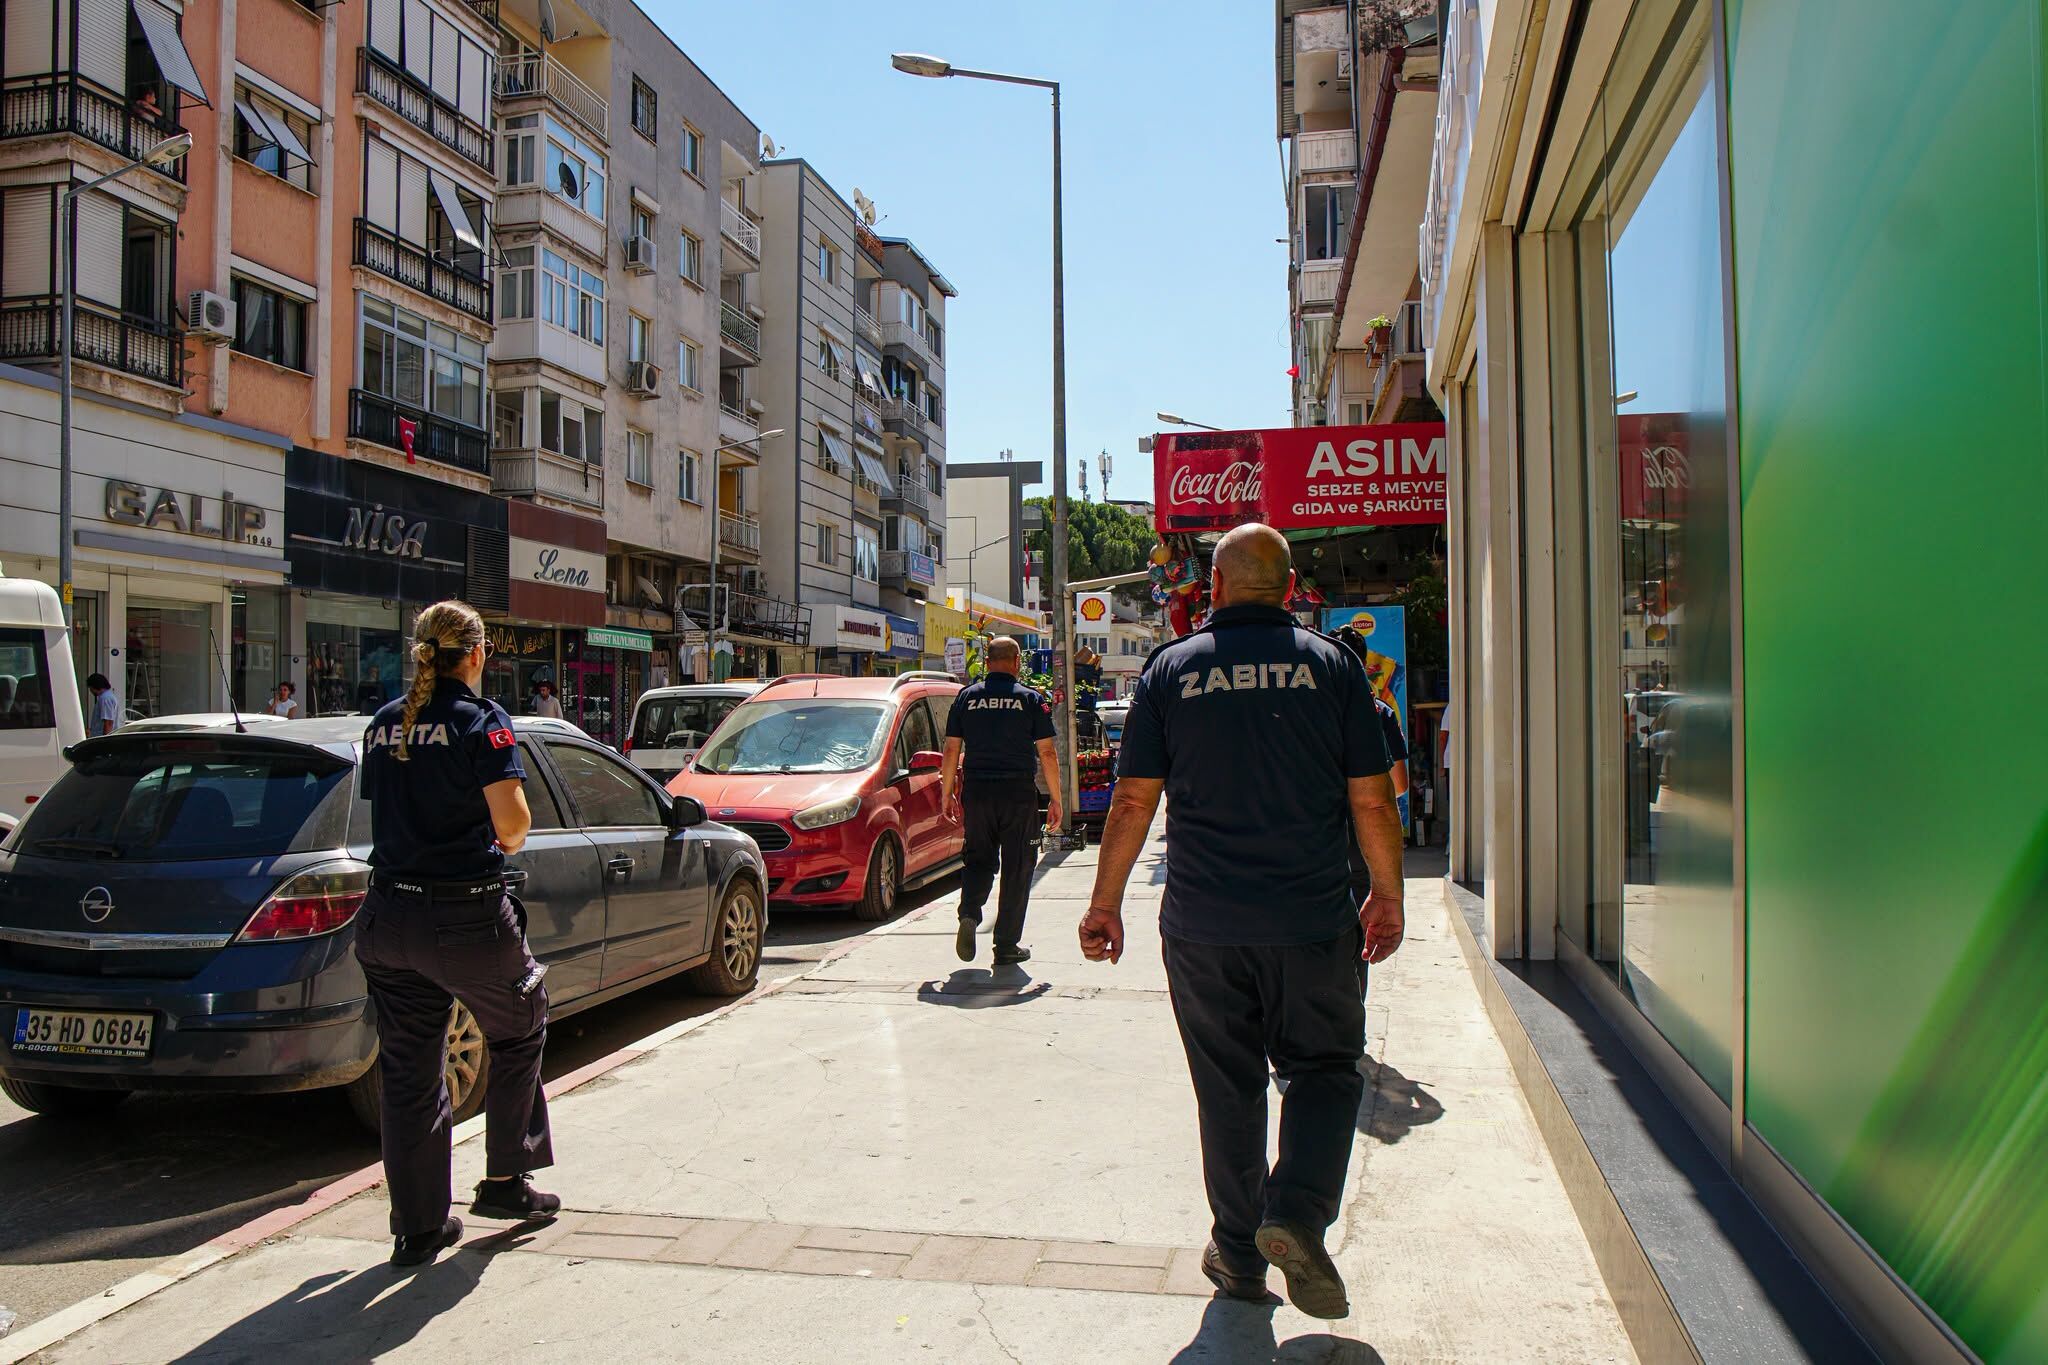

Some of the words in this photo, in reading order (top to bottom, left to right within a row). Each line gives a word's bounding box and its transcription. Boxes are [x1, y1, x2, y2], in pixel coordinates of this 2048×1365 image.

[1306, 438, 1446, 478] ASIM
[1169, 461, 1265, 506] Coca-Cola
[1307, 482, 1364, 497] SEBZE
[1368, 482, 1380, 495] &
[1384, 480, 1446, 495] MEYVE
[1292, 502, 1335, 515] GIDA
[1338, 503, 1358, 513] ve
[1363, 496, 1448, 517] ŞARKÜTE
[533, 548, 590, 588] Lena
[1353, 620, 1373, 629] Lipton
[1178, 663, 1318, 699] ZABITA
[967, 698, 1024, 711] ZABITA
[28, 1015, 53, 1042] 35
[59, 1017, 85, 1043] HD
[92, 1018, 147, 1046] 0684
